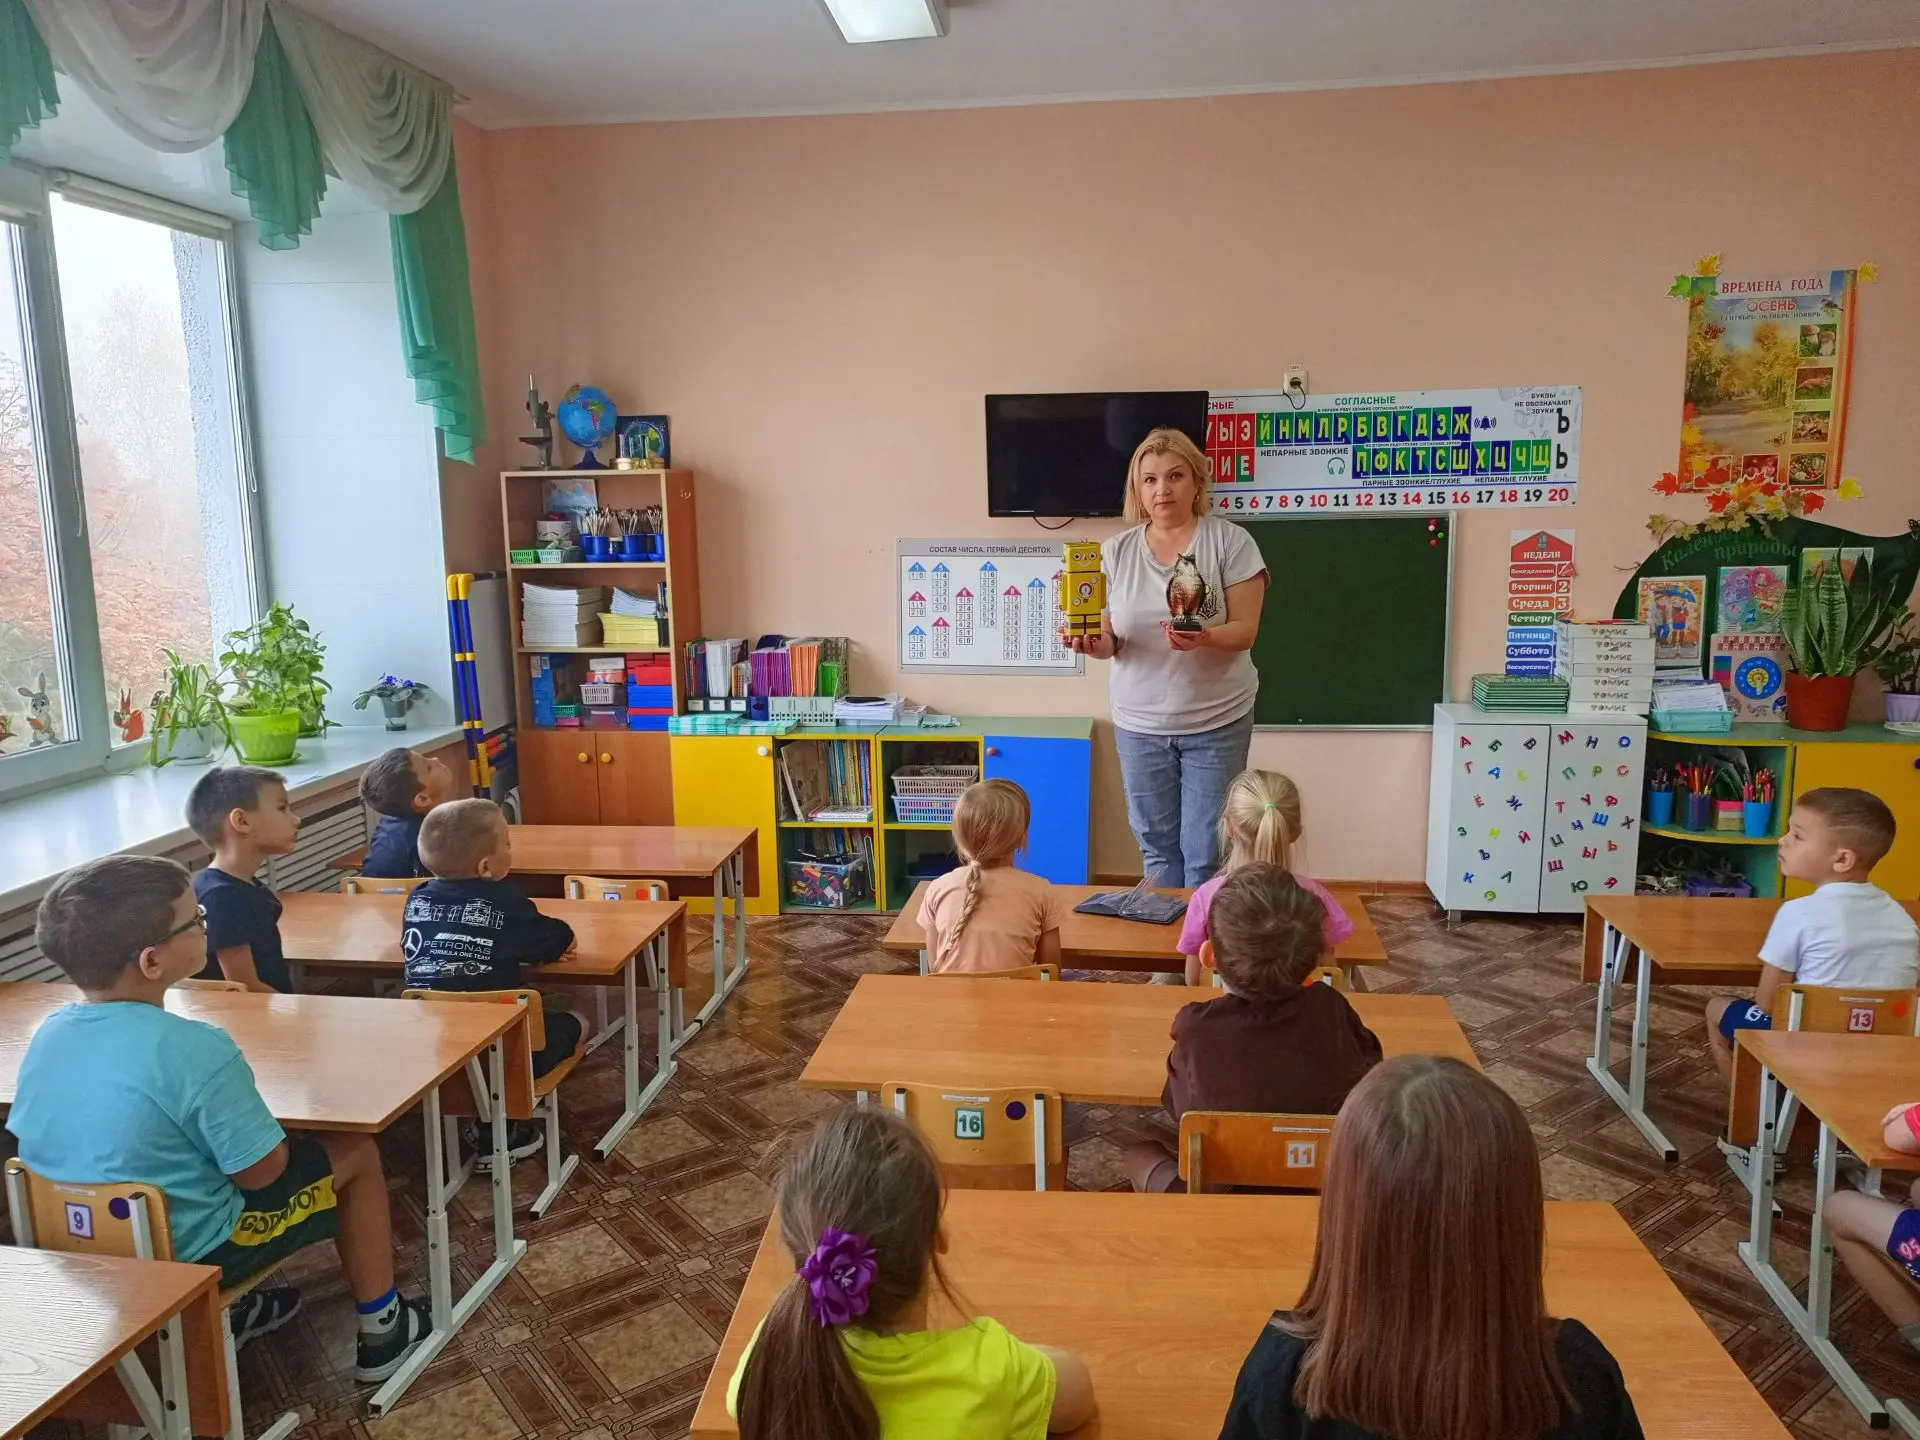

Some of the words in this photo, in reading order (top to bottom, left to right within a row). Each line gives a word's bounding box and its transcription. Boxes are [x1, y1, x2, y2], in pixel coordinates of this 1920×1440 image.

[1721, 280, 1782, 294] ВРЕМЕНА
[1791, 278, 1824, 292] ГОДА
[1747, 299, 1797, 312] ОСЕНЬ
[1334, 396, 1396, 406] СОГЛАСНЫЕ
[1531, 392, 1557, 400] БУКВЫ
[1514, 401, 1524, 410] НЕ
[1526, 399, 1572, 408] ОБОЗНАЧАЮТ
[1531, 408, 1554, 416] ЗВУКИ
[1220, 421, 1233, 441] Ы
[1240, 420, 1251, 440] Э
[1261, 414, 1270, 440] Й
[1280, 418, 1289, 439] Н
[1298, 418, 1309, 438] М
[1318, 418, 1328, 438] Л
[1338, 417, 1347, 437] Р
[1357, 416, 1367, 437] Б
[1377, 416, 1387, 436] В
[1398, 415, 1406, 436] Г
[1415, 414, 1427, 436] Д
[1437, 414, 1446, 435] З
[1454, 413, 1469, 434] Ж
[1556, 408, 1570, 433] Ъ
[1260, 449, 1308, 458] НЕПАРНЫЕ
[1309, 448, 1348, 456] ЗВОНКИЕ
[1556, 443, 1568, 469] Ь
[1221, 456, 1231, 476] И
[1240, 455, 1249, 475] Е
[1356, 452, 1367, 472] П
[1374, 450, 1388, 472] Ф
[1395, 450, 1406, 471] К
[1415, 450, 1425, 470] Т
[1436, 449, 1445, 470] С
[1452, 449, 1468, 470] Ш
[1475, 448, 1486, 469] Х
[1495, 447, 1506, 469] Ц
[1517, 447, 1526, 468] Ч
[1532, 446, 1549, 468] Щ
[1362, 479, 1394, 487] ПАРНЫЕ
[1395, 478, 1461, 486] ЗВОНКИЕ/ГЛУХИЕ
[1474, 476, 1518, 484] НЕПАРНЫЕ
[1519, 475, 1547, 483] ГЛУХИЕ
[1220, 497, 1229, 509] 4
[1235, 497, 1244, 509] 5
[1250, 496, 1259, 509] 6
[1265, 496, 1274, 508] 7
[1279, 495, 1289, 508] 8
[1294, 495, 1304, 507] 9
[1310, 494, 1327, 507] 10
[1333, 494, 1350, 507] 11
[1355, 493, 1374, 506] 12
[1379, 492, 1397, 506] 13
[1403, 492, 1422, 505] 14
[1428, 491, 1446, 504] 15
[1452, 491, 1470, 504] 16
[1476, 490, 1494, 503] 17
[1499, 490, 1518, 503] 18
[1524, 489, 1543, 502] 19
[1548, 488, 1569, 502] 20
[929, 546, 957, 554] СОСТАВ
[986, 545, 1017, 554] ПЕРВЫЙ
[1017, 546, 1052, 555] ДЕСЯТОК
[1523, 551, 1560, 560] НЕДЕЛЯ
[1511, 583, 1553, 592] Вторник
[1558, 581, 1568, 592] 2
[1512, 598, 1549, 610] Среда
[1557, 598, 1567, 609] 3
[1510, 613, 1553, 624] Четверг
[1508, 631, 1550, 642] Пятница
[1507, 646, 1550, 658] Суббота
[1506, 663, 1550, 672] Воскресенье
[1460, 736, 1472, 749] А
[1523, 737, 1537, 750] В
[1557, 730, 1574, 745] М
[1618, 736, 1631, 748] О
[1562, 766, 1576, 779] П
[1592, 765, 1602, 777] Р
[1617, 765, 1630, 777] С
[1506, 795, 1522, 811] Ж
[1580, 793, 1592, 806] У
[1555, 801, 1565, 813] Т
[1620, 815, 1635, 829] Х
[1457, 826, 1467, 837] З
[1518, 830, 1531, 844] Й
[1582, 846, 1597, 859] Ы
[1462, 871, 1474, 883] К
[1603, 876, 1618, 889] Я
[1570, 880, 1588, 893] Ю
[453, 933, 494, 947] AMG
[423, 940, 491, 955] PETRONAS
[430, 949, 458, 957] FORMULA
[474, 953, 491, 961] TEAM
[1853, 1013, 1871, 1027] 13
[959, 1114, 981, 1133] 16
[1290, 1147, 1312, 1164] 11
[73, 1211, 84, 1231] 9
